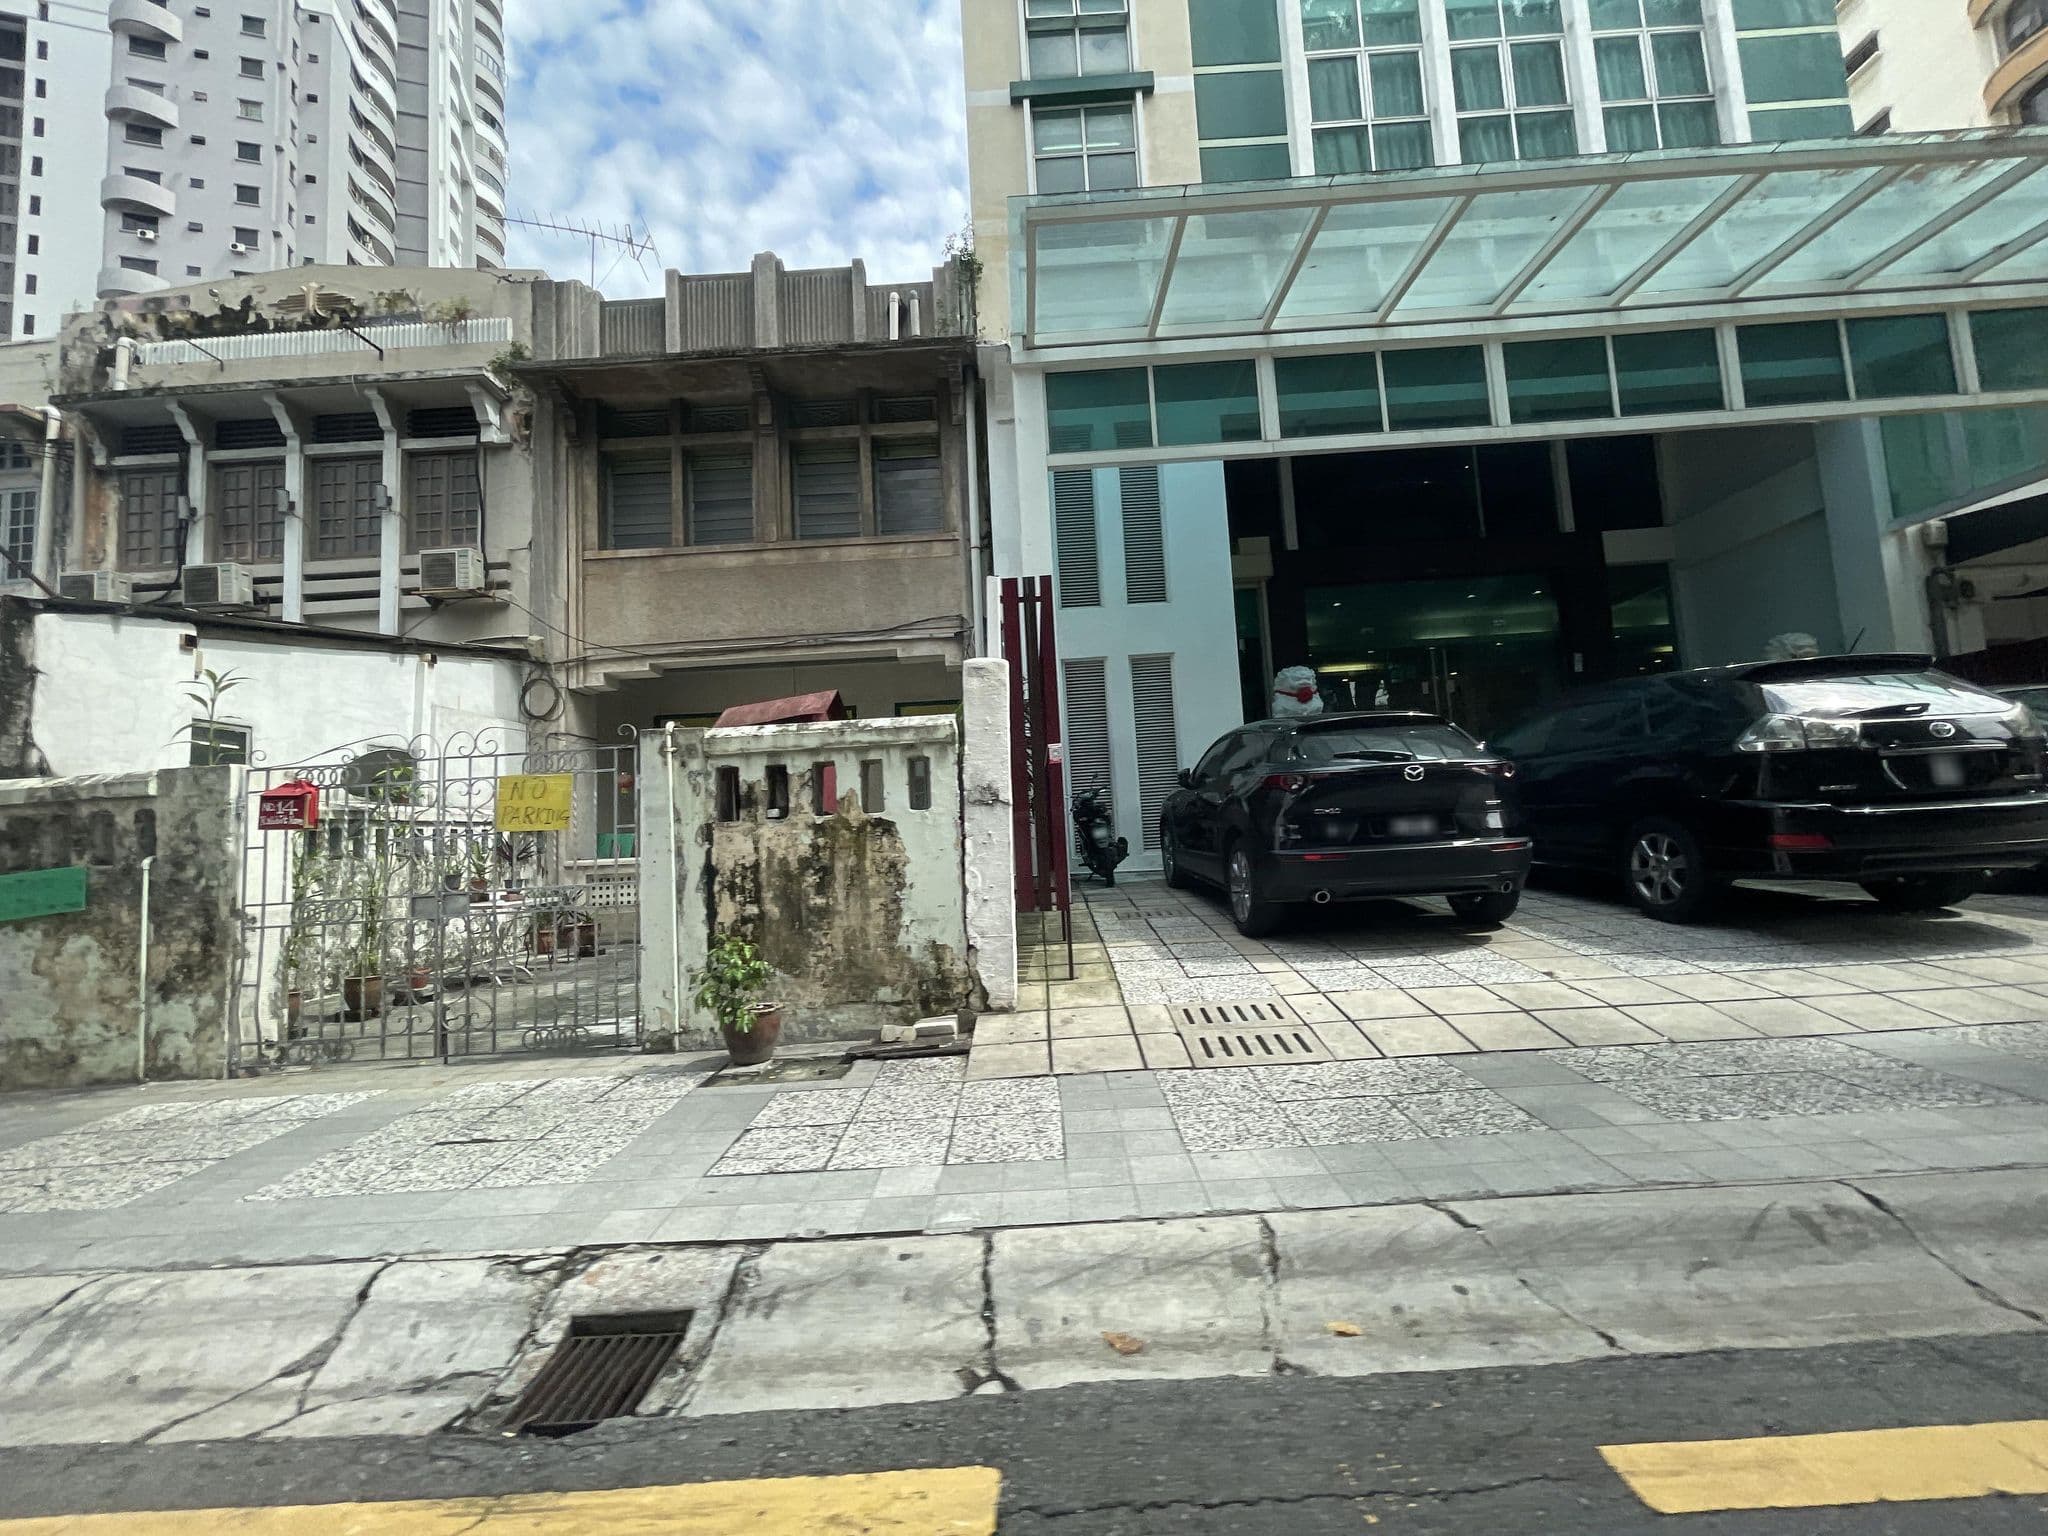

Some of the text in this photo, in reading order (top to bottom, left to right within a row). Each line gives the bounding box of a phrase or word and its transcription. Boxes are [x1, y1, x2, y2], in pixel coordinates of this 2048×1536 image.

[508, 778, 547, 801] NO
[276, 800, 299, 816] 14
[501, 805, 570, 825] PARKING
